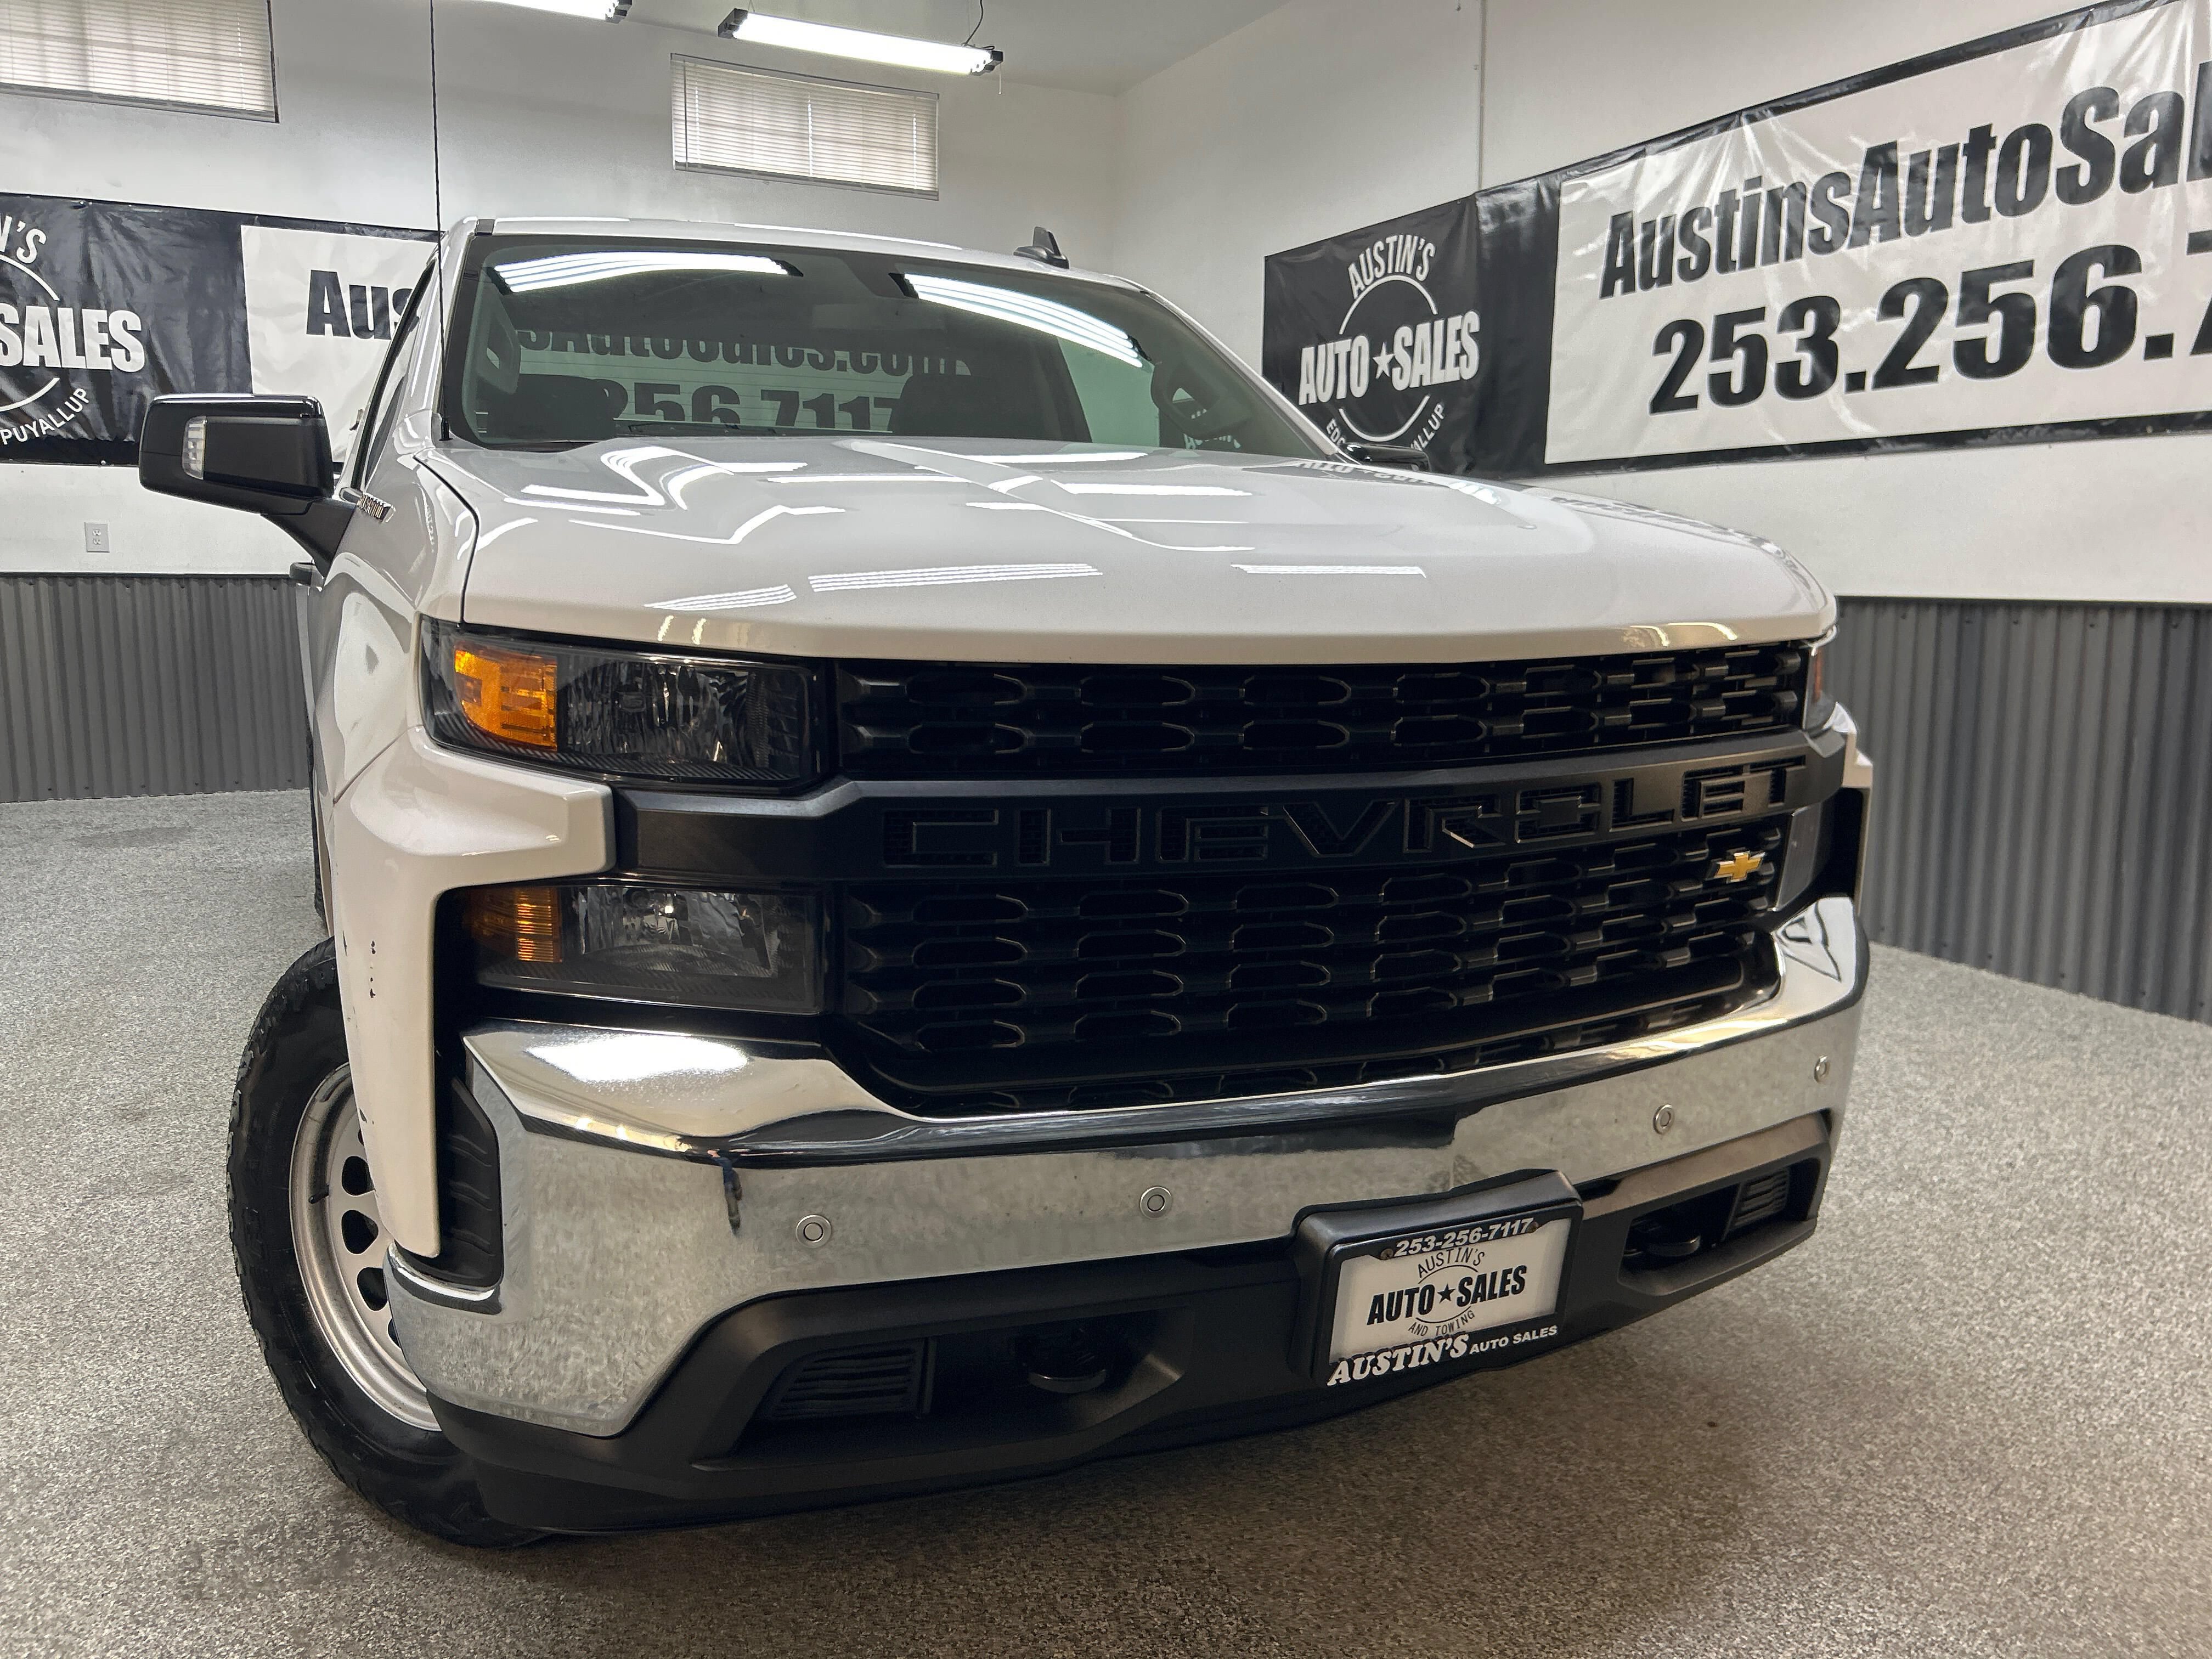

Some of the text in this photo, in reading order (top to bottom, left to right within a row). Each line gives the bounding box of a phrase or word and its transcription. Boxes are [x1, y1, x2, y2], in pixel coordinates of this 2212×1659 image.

[1348, 234, 1435, 299] AUSTIN'S
[0, 302, 145, 373] SALES
[1299, 311, 1480, 405] AUTO SALES
[0, 388, 89, 444] PUYALLUP
[882, 754, 1806, 866] CHEVROLET
[1394, 1218, 1534, 1257] 253-256-7117
[1418, 1247, 1485, 1278] AUSTIN'S
[1367, 1265, 1527, 1325] AUTO SALES
[1408, 1310, 1475, 1336] AND TOWING
[1327, 1324, 1558, 1386] AUSTIN'S AUTO SALES
